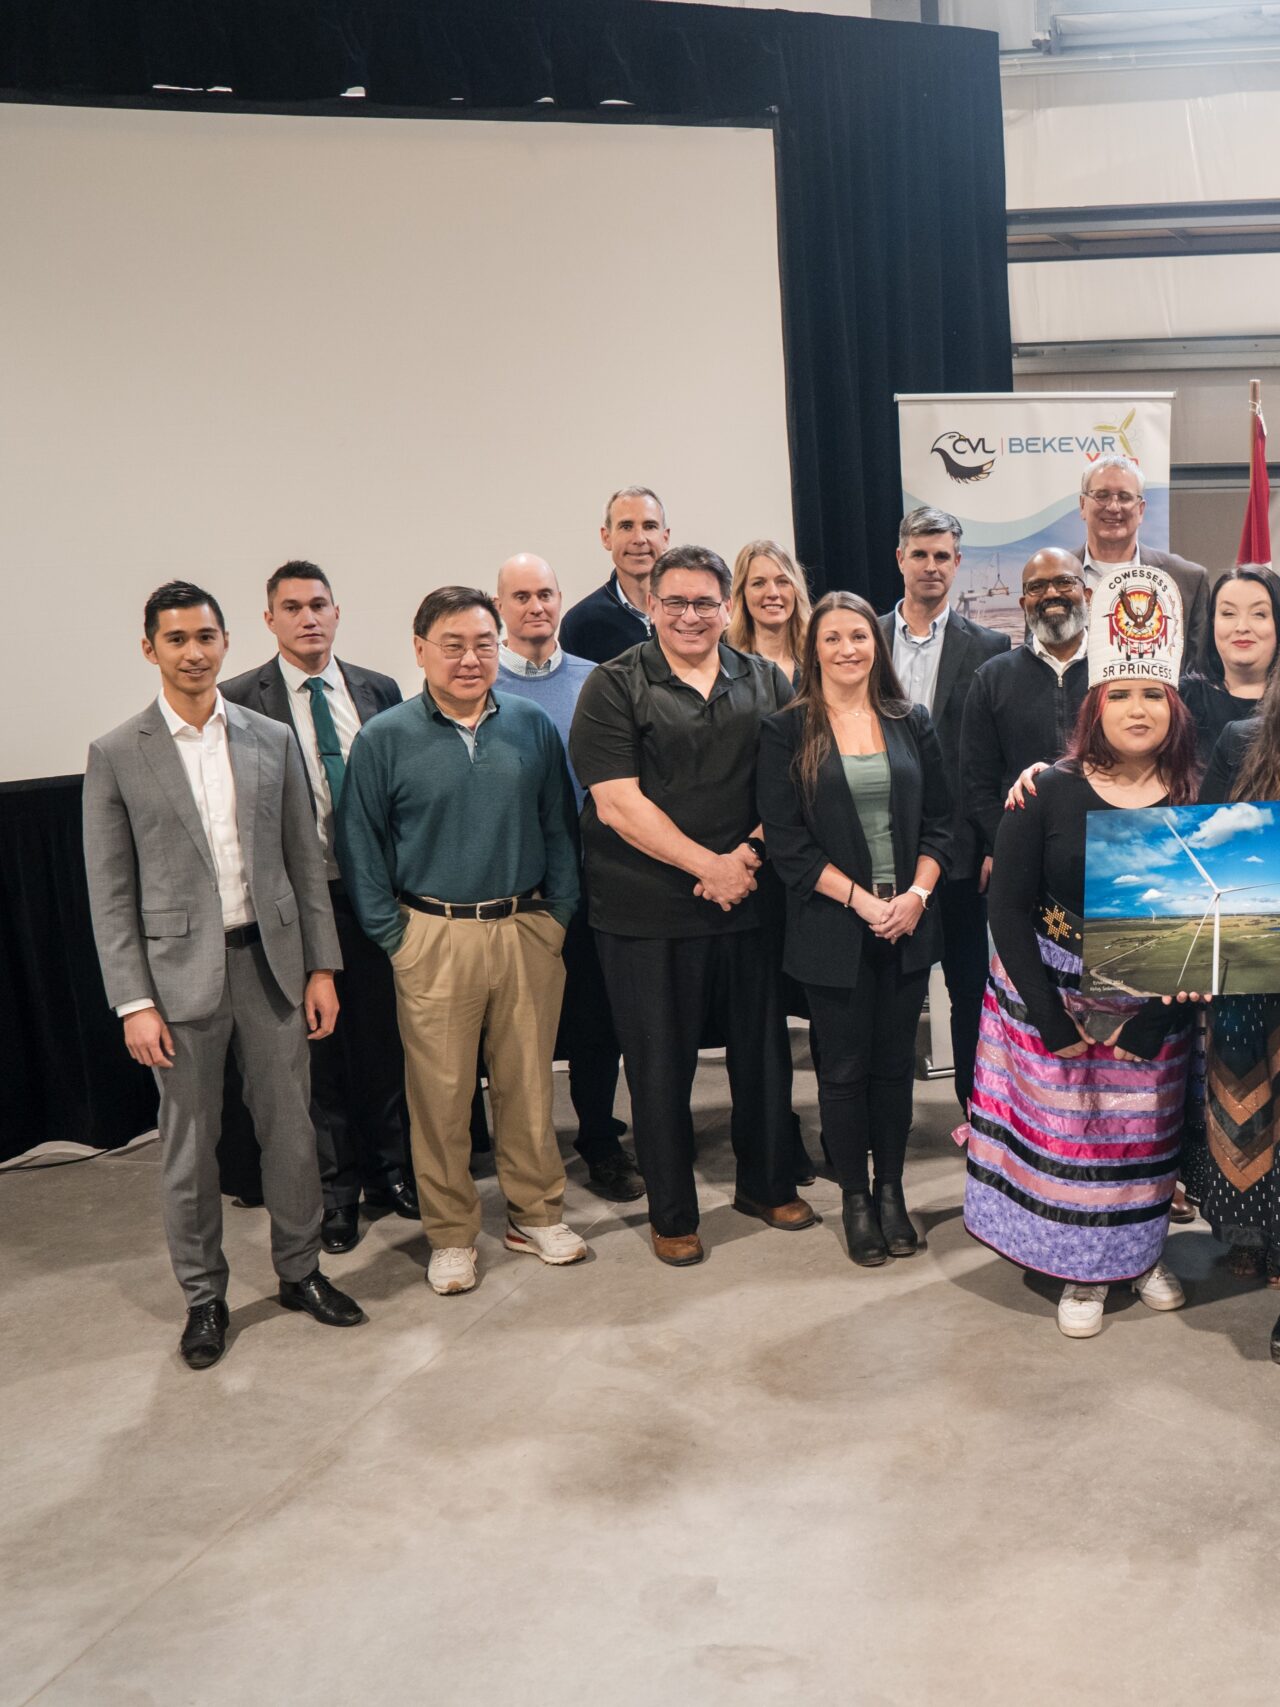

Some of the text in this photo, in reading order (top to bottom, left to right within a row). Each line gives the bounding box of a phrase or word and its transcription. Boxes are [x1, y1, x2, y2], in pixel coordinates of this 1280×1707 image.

[952, 436, 1115, 455] CVL BEKEVAR
[1108, 569, 1168, 593] COWESSESS
[1102, 663, 1172, 679] SR PRINCESS
